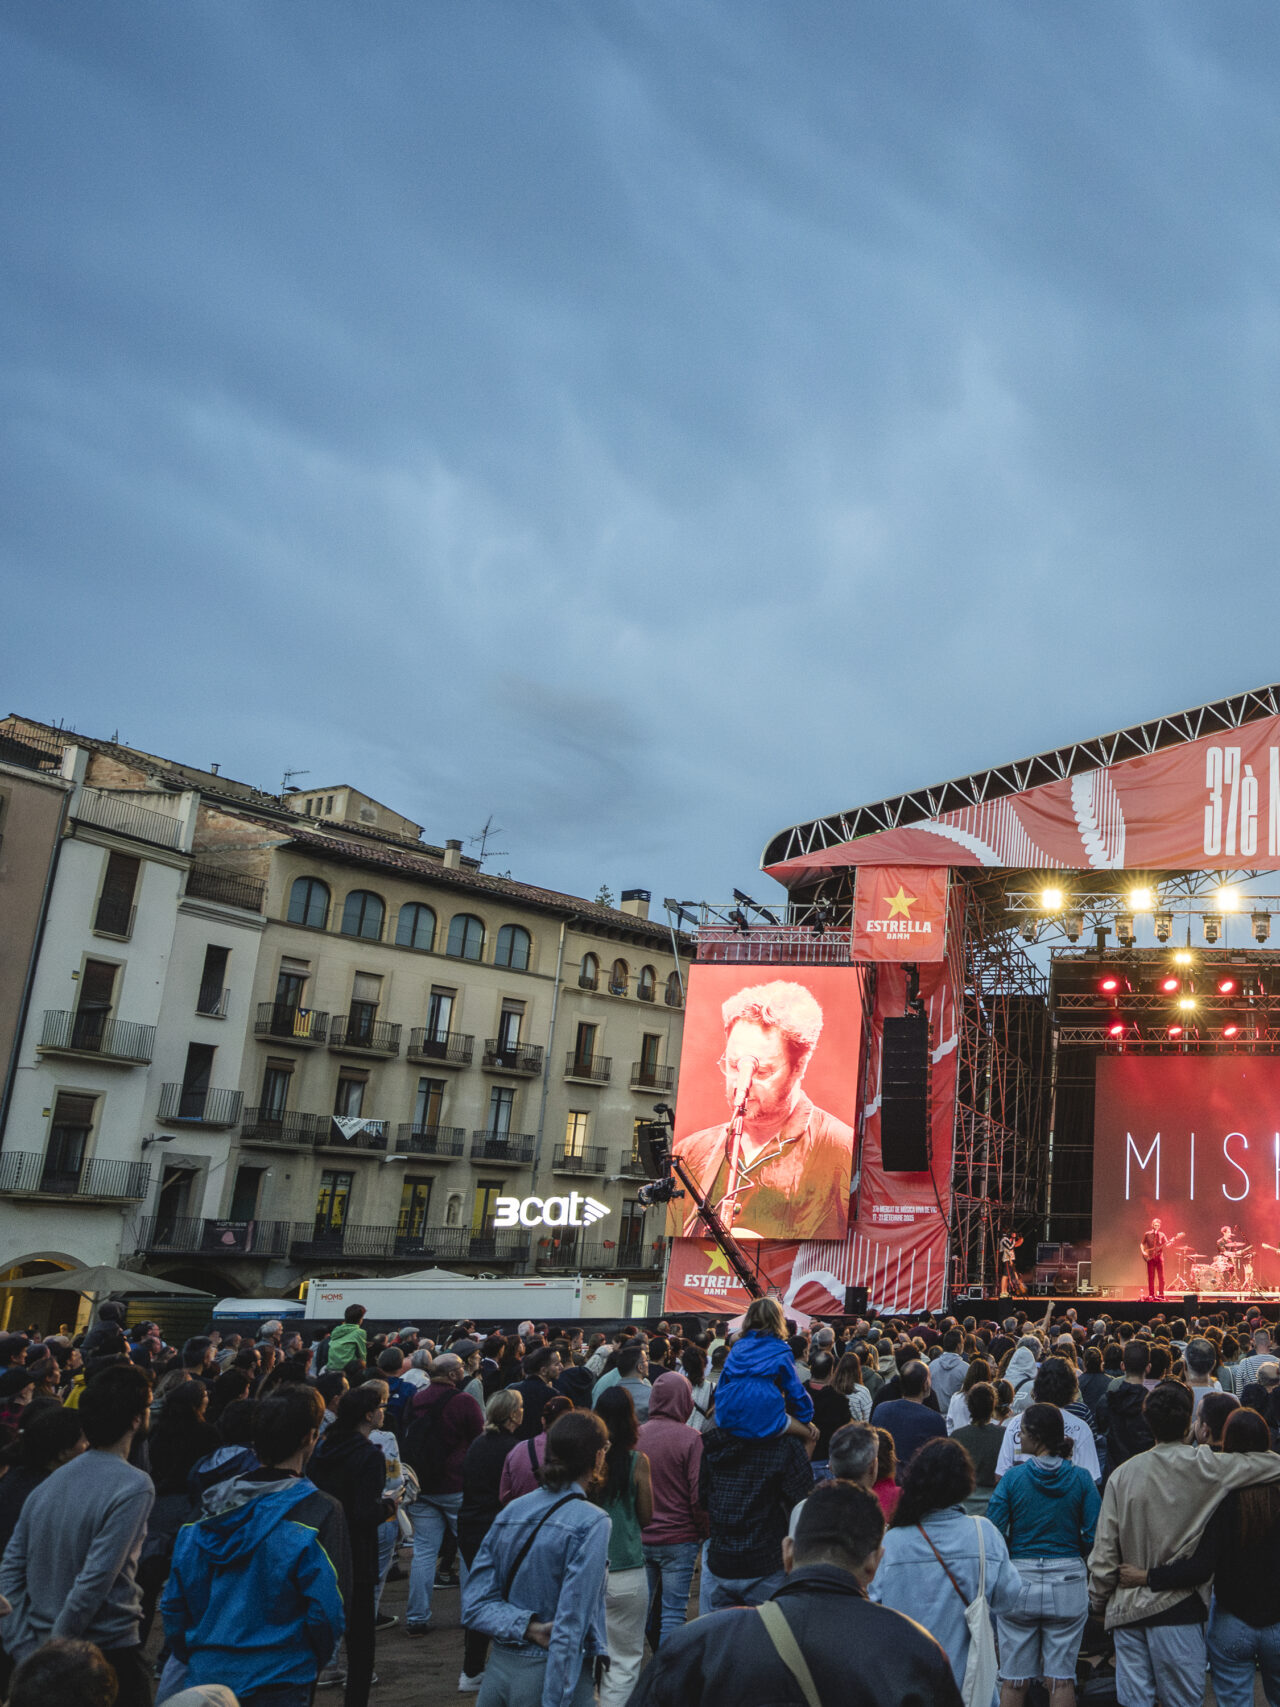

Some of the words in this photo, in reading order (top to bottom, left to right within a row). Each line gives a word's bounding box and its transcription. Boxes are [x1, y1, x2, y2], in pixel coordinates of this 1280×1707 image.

[1203, 746, 1259, 856] 37è
[866, 920, 932, 933] ESTRELLA
[494, 1191, 584, 1226] 3cat
[684, 1274, 744, 1289] ESTRELL
[704, 1288, 727, 1296] DAMM
